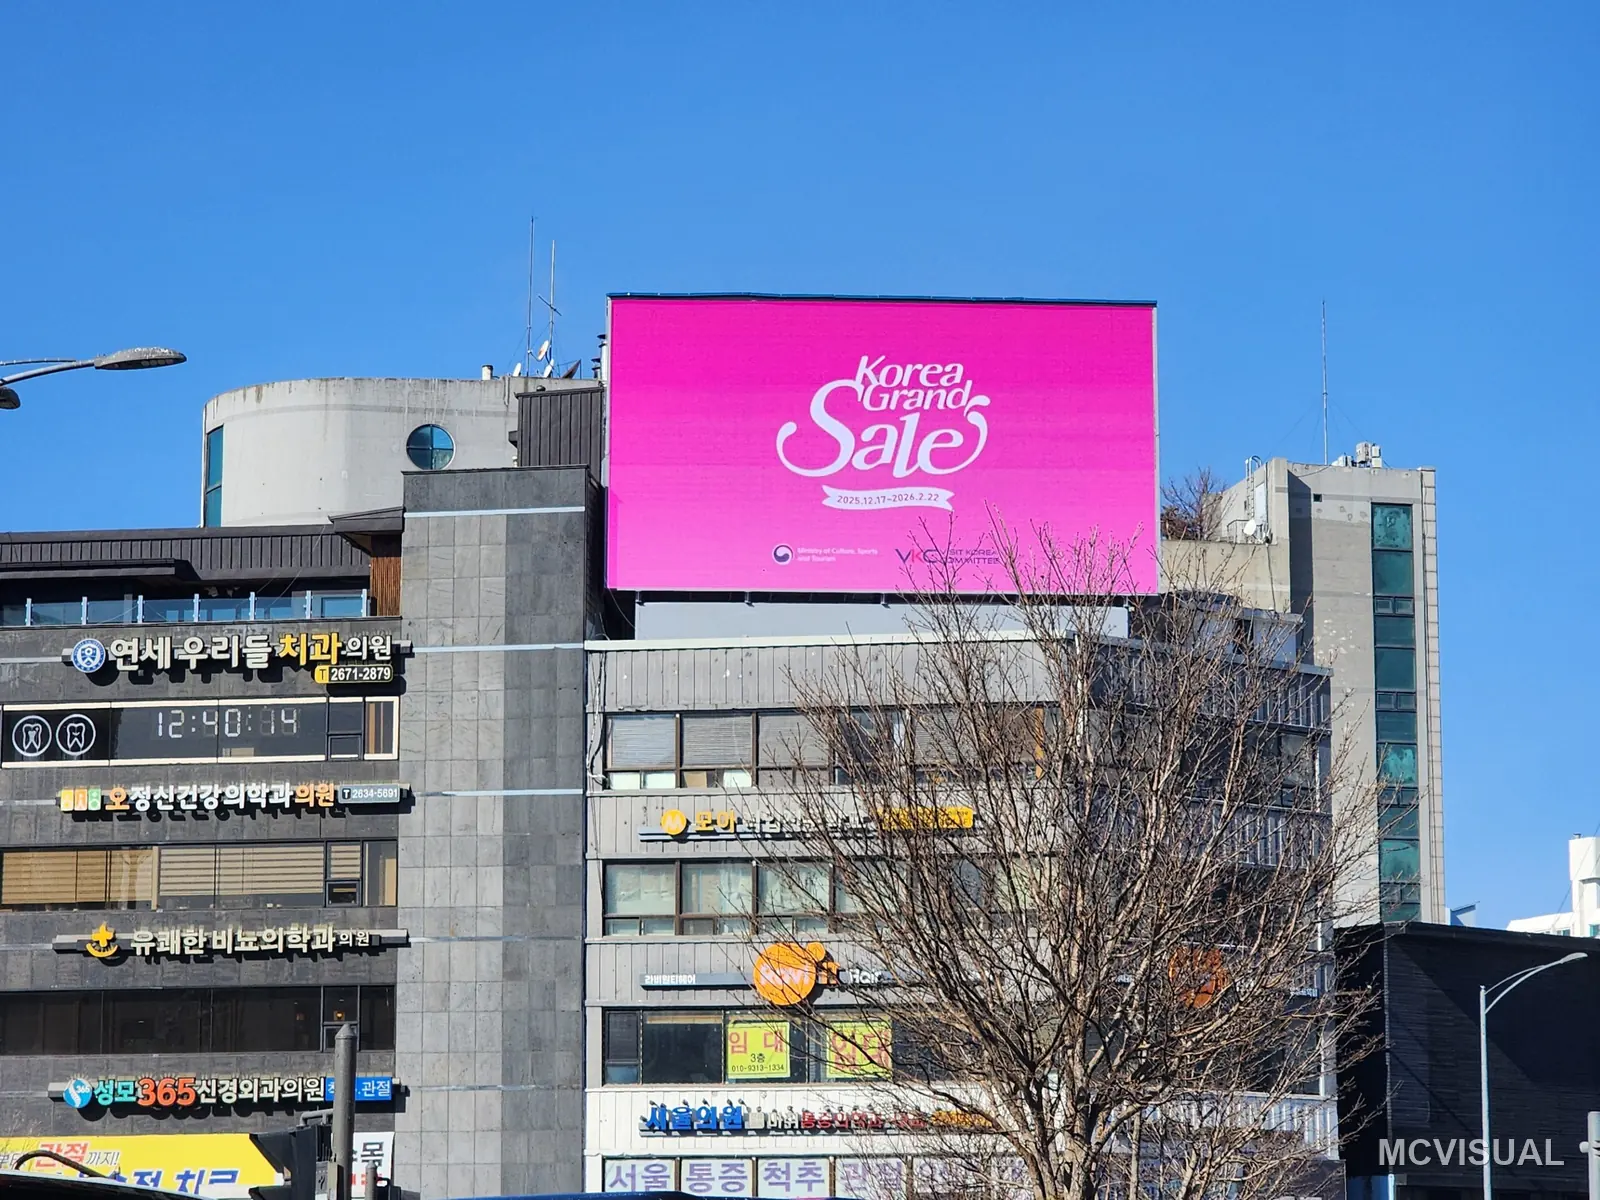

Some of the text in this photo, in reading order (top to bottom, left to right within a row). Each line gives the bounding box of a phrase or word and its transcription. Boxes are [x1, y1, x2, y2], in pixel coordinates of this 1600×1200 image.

[856, 355, 964, 388] Korea
[863, 380, 973, 411] Grand
[776, 379, 990, 478] Sale
[895, 548, 938, 564] VKC
[330, 667, 392, 682] 2671-2879
[352, 787, 398, 799] 2634-5691
[131, 928, 207, 956] 유쾌한
[732, 1064, 784, 1072] 010-9313-1334
[751, 1053, 765, 1064] 3층
[686, 1163, 748, 1193] 통증
[763, 1162, 825, 1192] 척추
